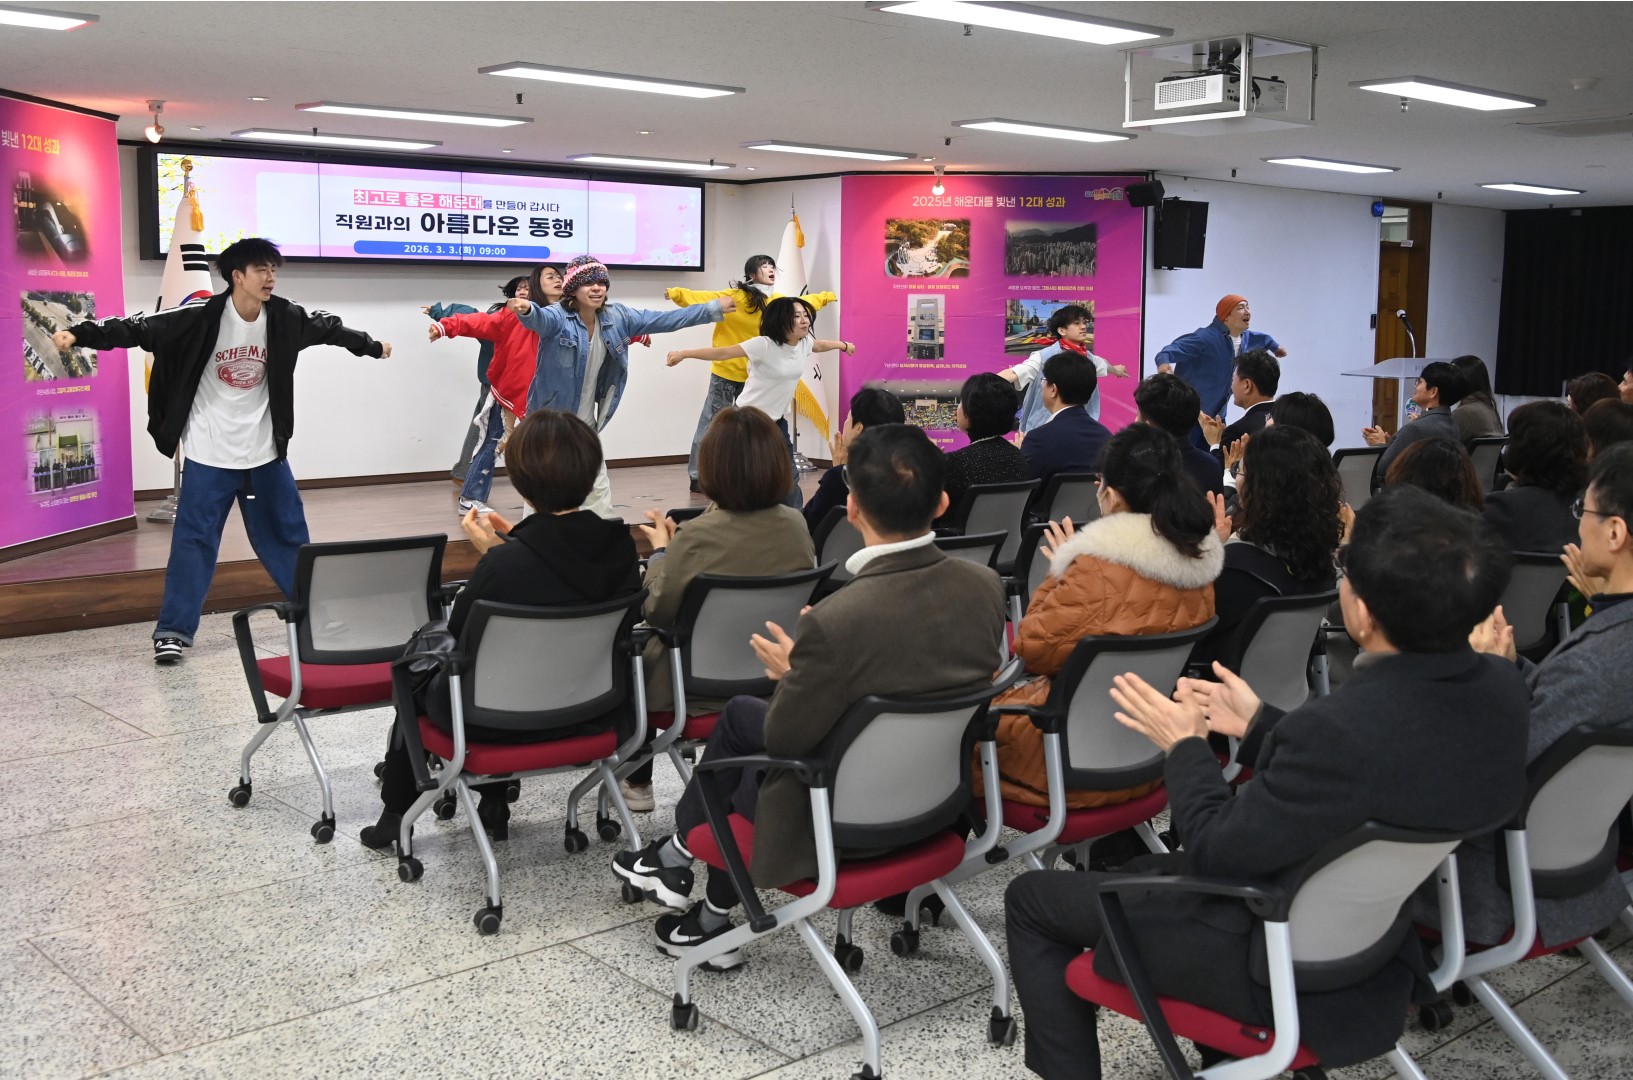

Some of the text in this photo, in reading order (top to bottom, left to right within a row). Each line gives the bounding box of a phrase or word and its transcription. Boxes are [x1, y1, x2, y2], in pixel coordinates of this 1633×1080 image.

[1, 130, 61, 155] 빛낸 12대 성과
[354, 190, 560, 213] 최고로 좋은 해운대를 만들어 갑시다
[912, 195, 1066, 209] 2025년 해운대를 빛낸 12대 성과
[335, 212, 574, 239] 직원과의 아름다운 동행
[404, 244, 507, 256] 2026. 3. 3.(화) 09:00
